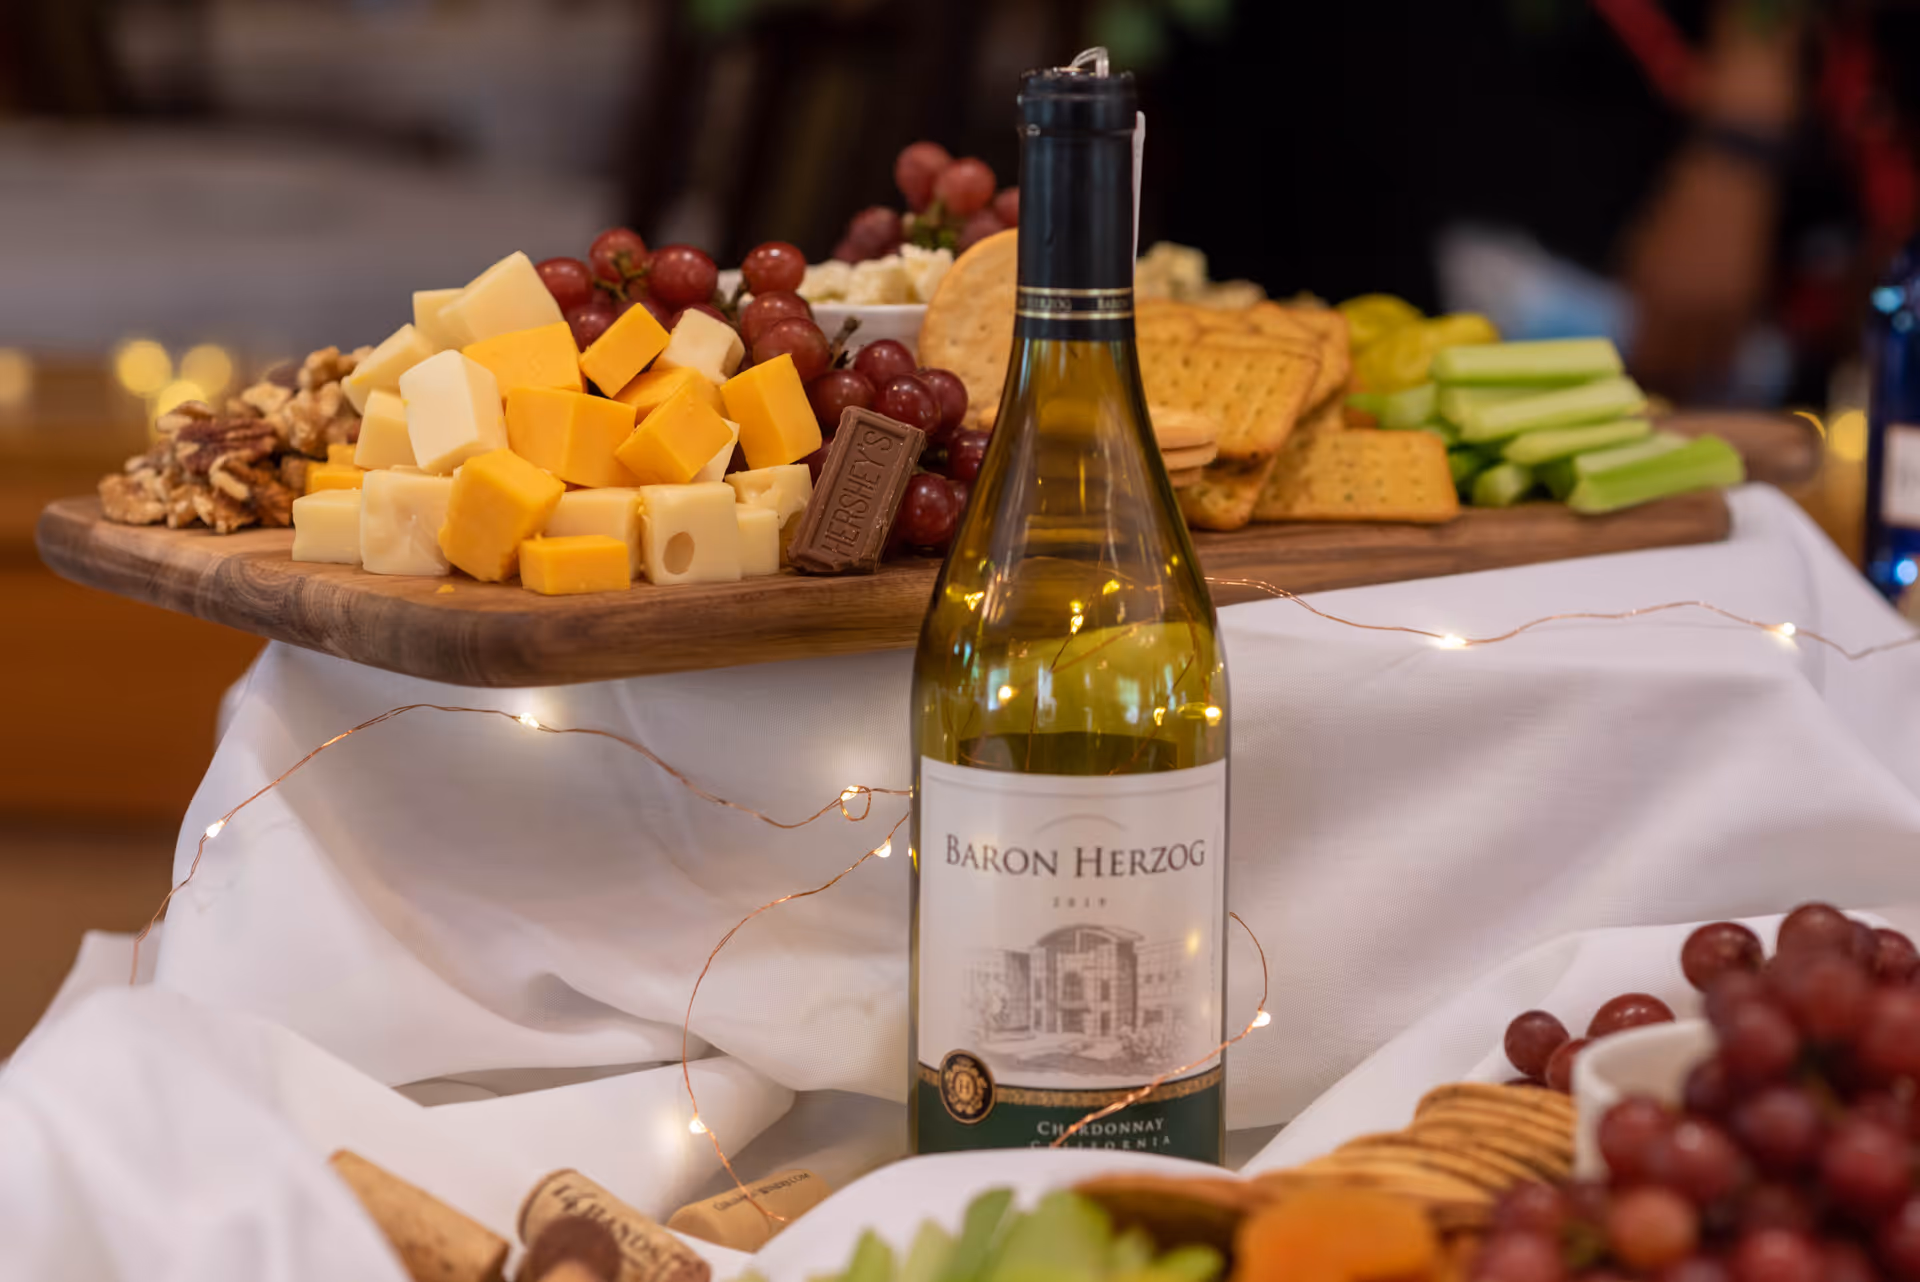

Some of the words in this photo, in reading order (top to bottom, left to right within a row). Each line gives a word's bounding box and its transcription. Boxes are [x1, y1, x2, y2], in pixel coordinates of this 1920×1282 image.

[821, 430, 893, 557] HERSHEY'S
[945, 833, 1059, 878] BARON
[1074, 839, 1206, 878] HERZOG
